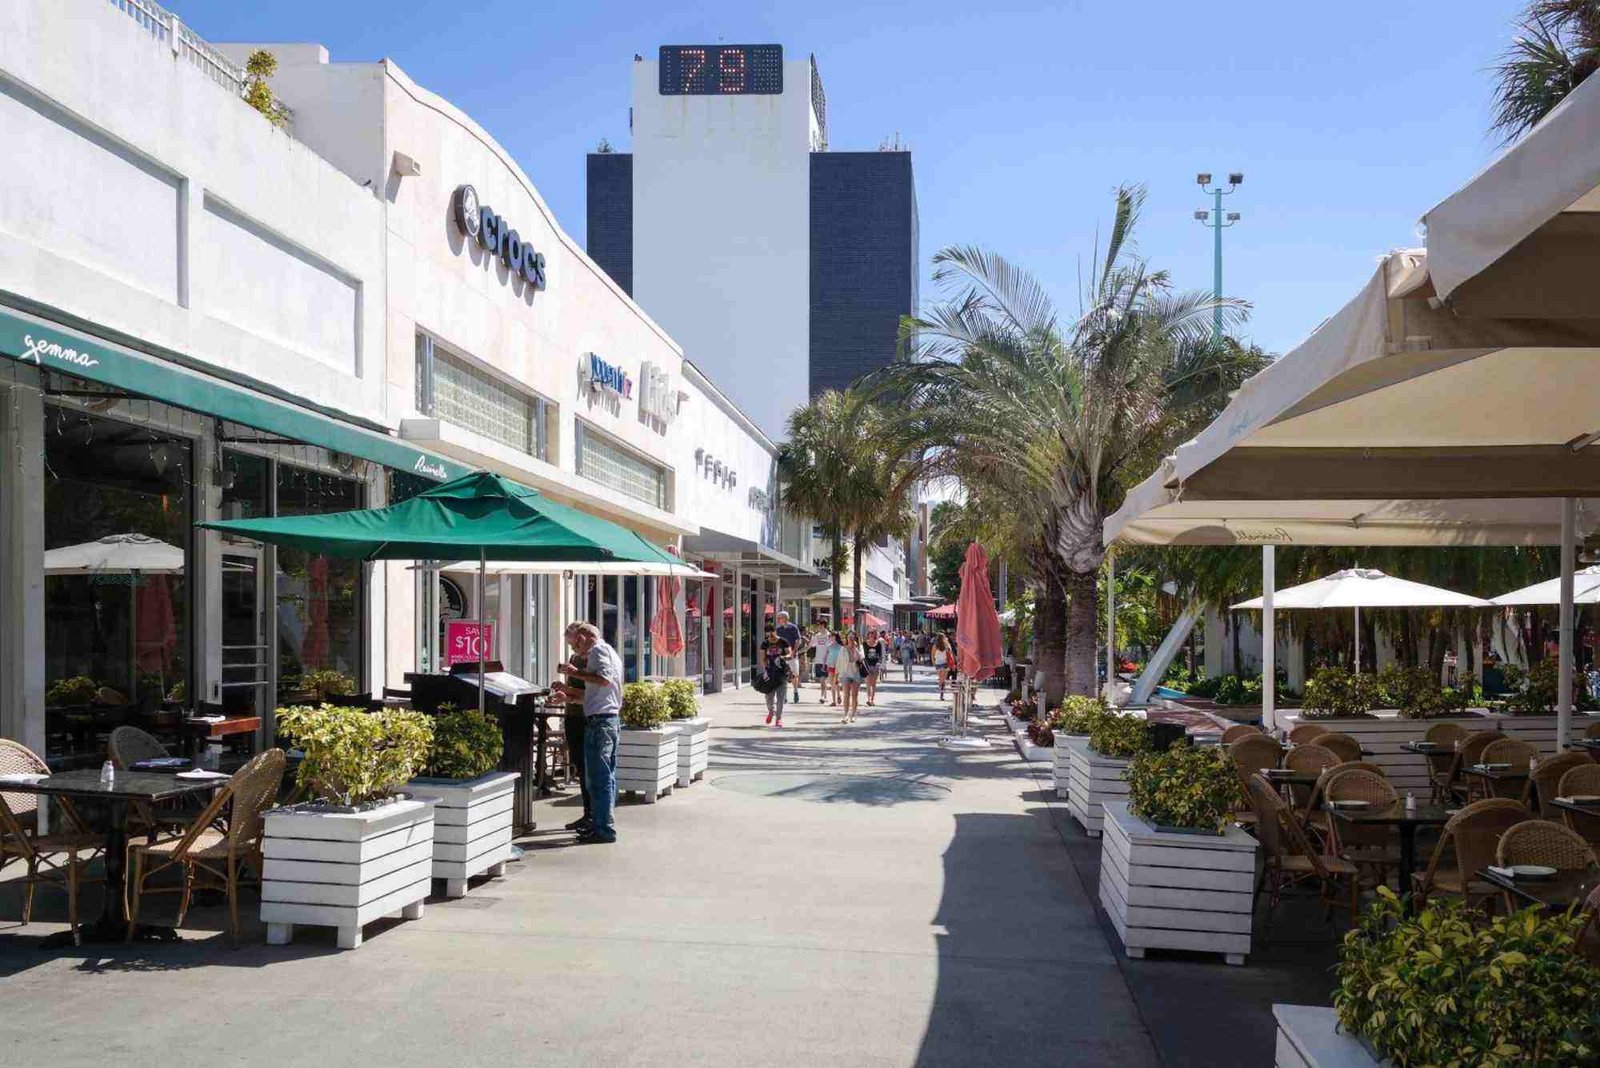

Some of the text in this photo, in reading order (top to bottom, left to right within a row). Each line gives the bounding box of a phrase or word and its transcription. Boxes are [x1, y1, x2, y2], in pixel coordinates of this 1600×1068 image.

[480, 205, 546, 292] crocs
[18, 334, 100, 367] gemma
[465, 626, 488, 636] SAVE
[455, 635, 488, 656] $10
